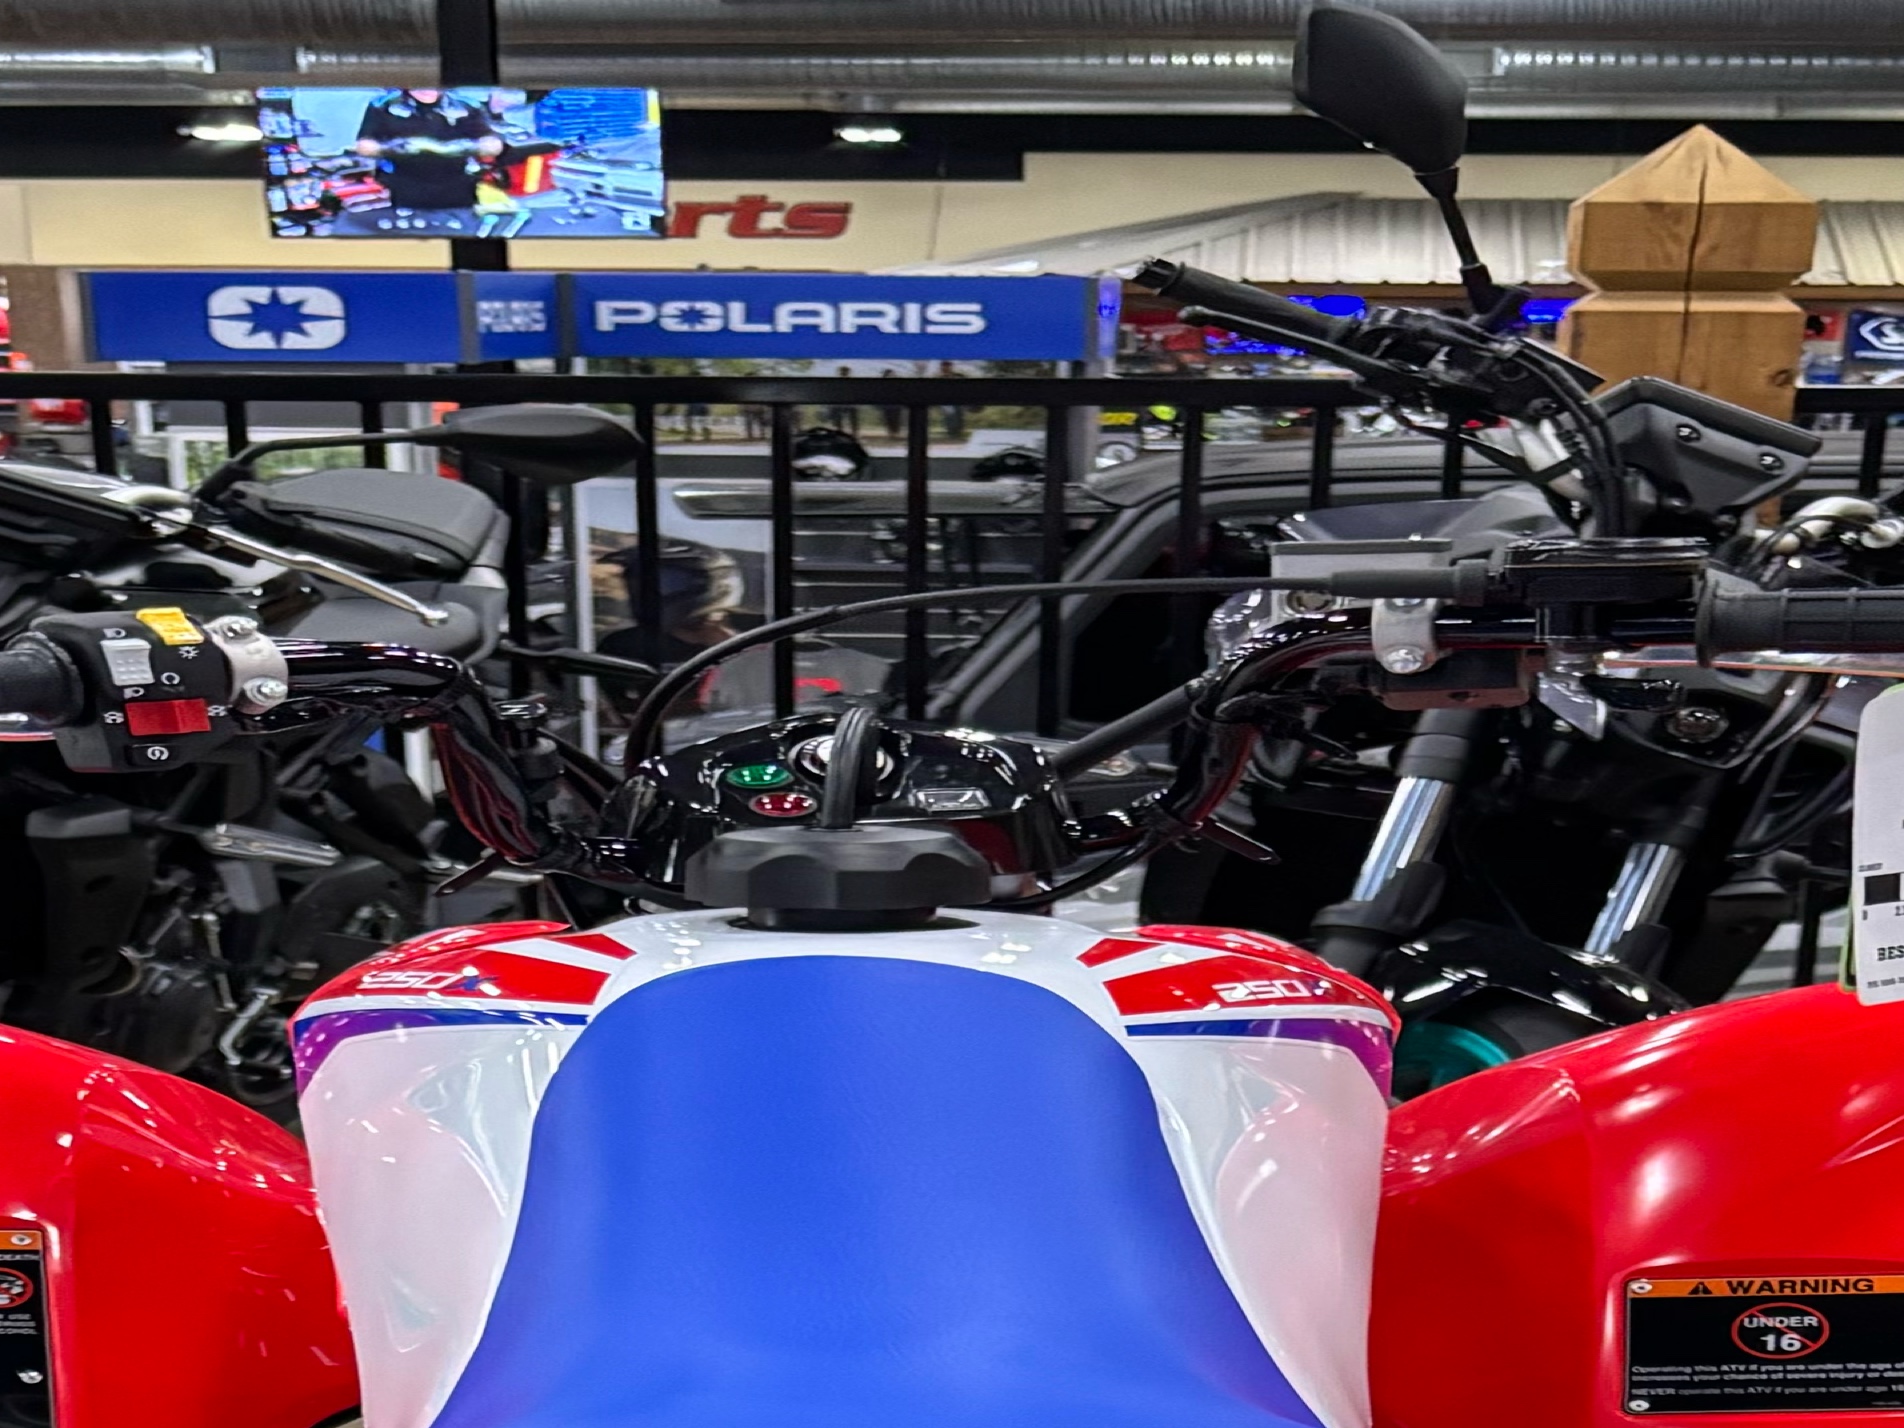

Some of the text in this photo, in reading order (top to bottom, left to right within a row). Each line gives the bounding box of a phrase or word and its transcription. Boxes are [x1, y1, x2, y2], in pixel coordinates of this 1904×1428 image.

[668, 194, 853, 239] rts
[596, 301, 987, 335] POLARIS
[1726, 1278, 1874, 1294] WARNING
[1743, 1316, 1819, 1328] UNDER
[1760, 1334, 1802, 1352] 16
